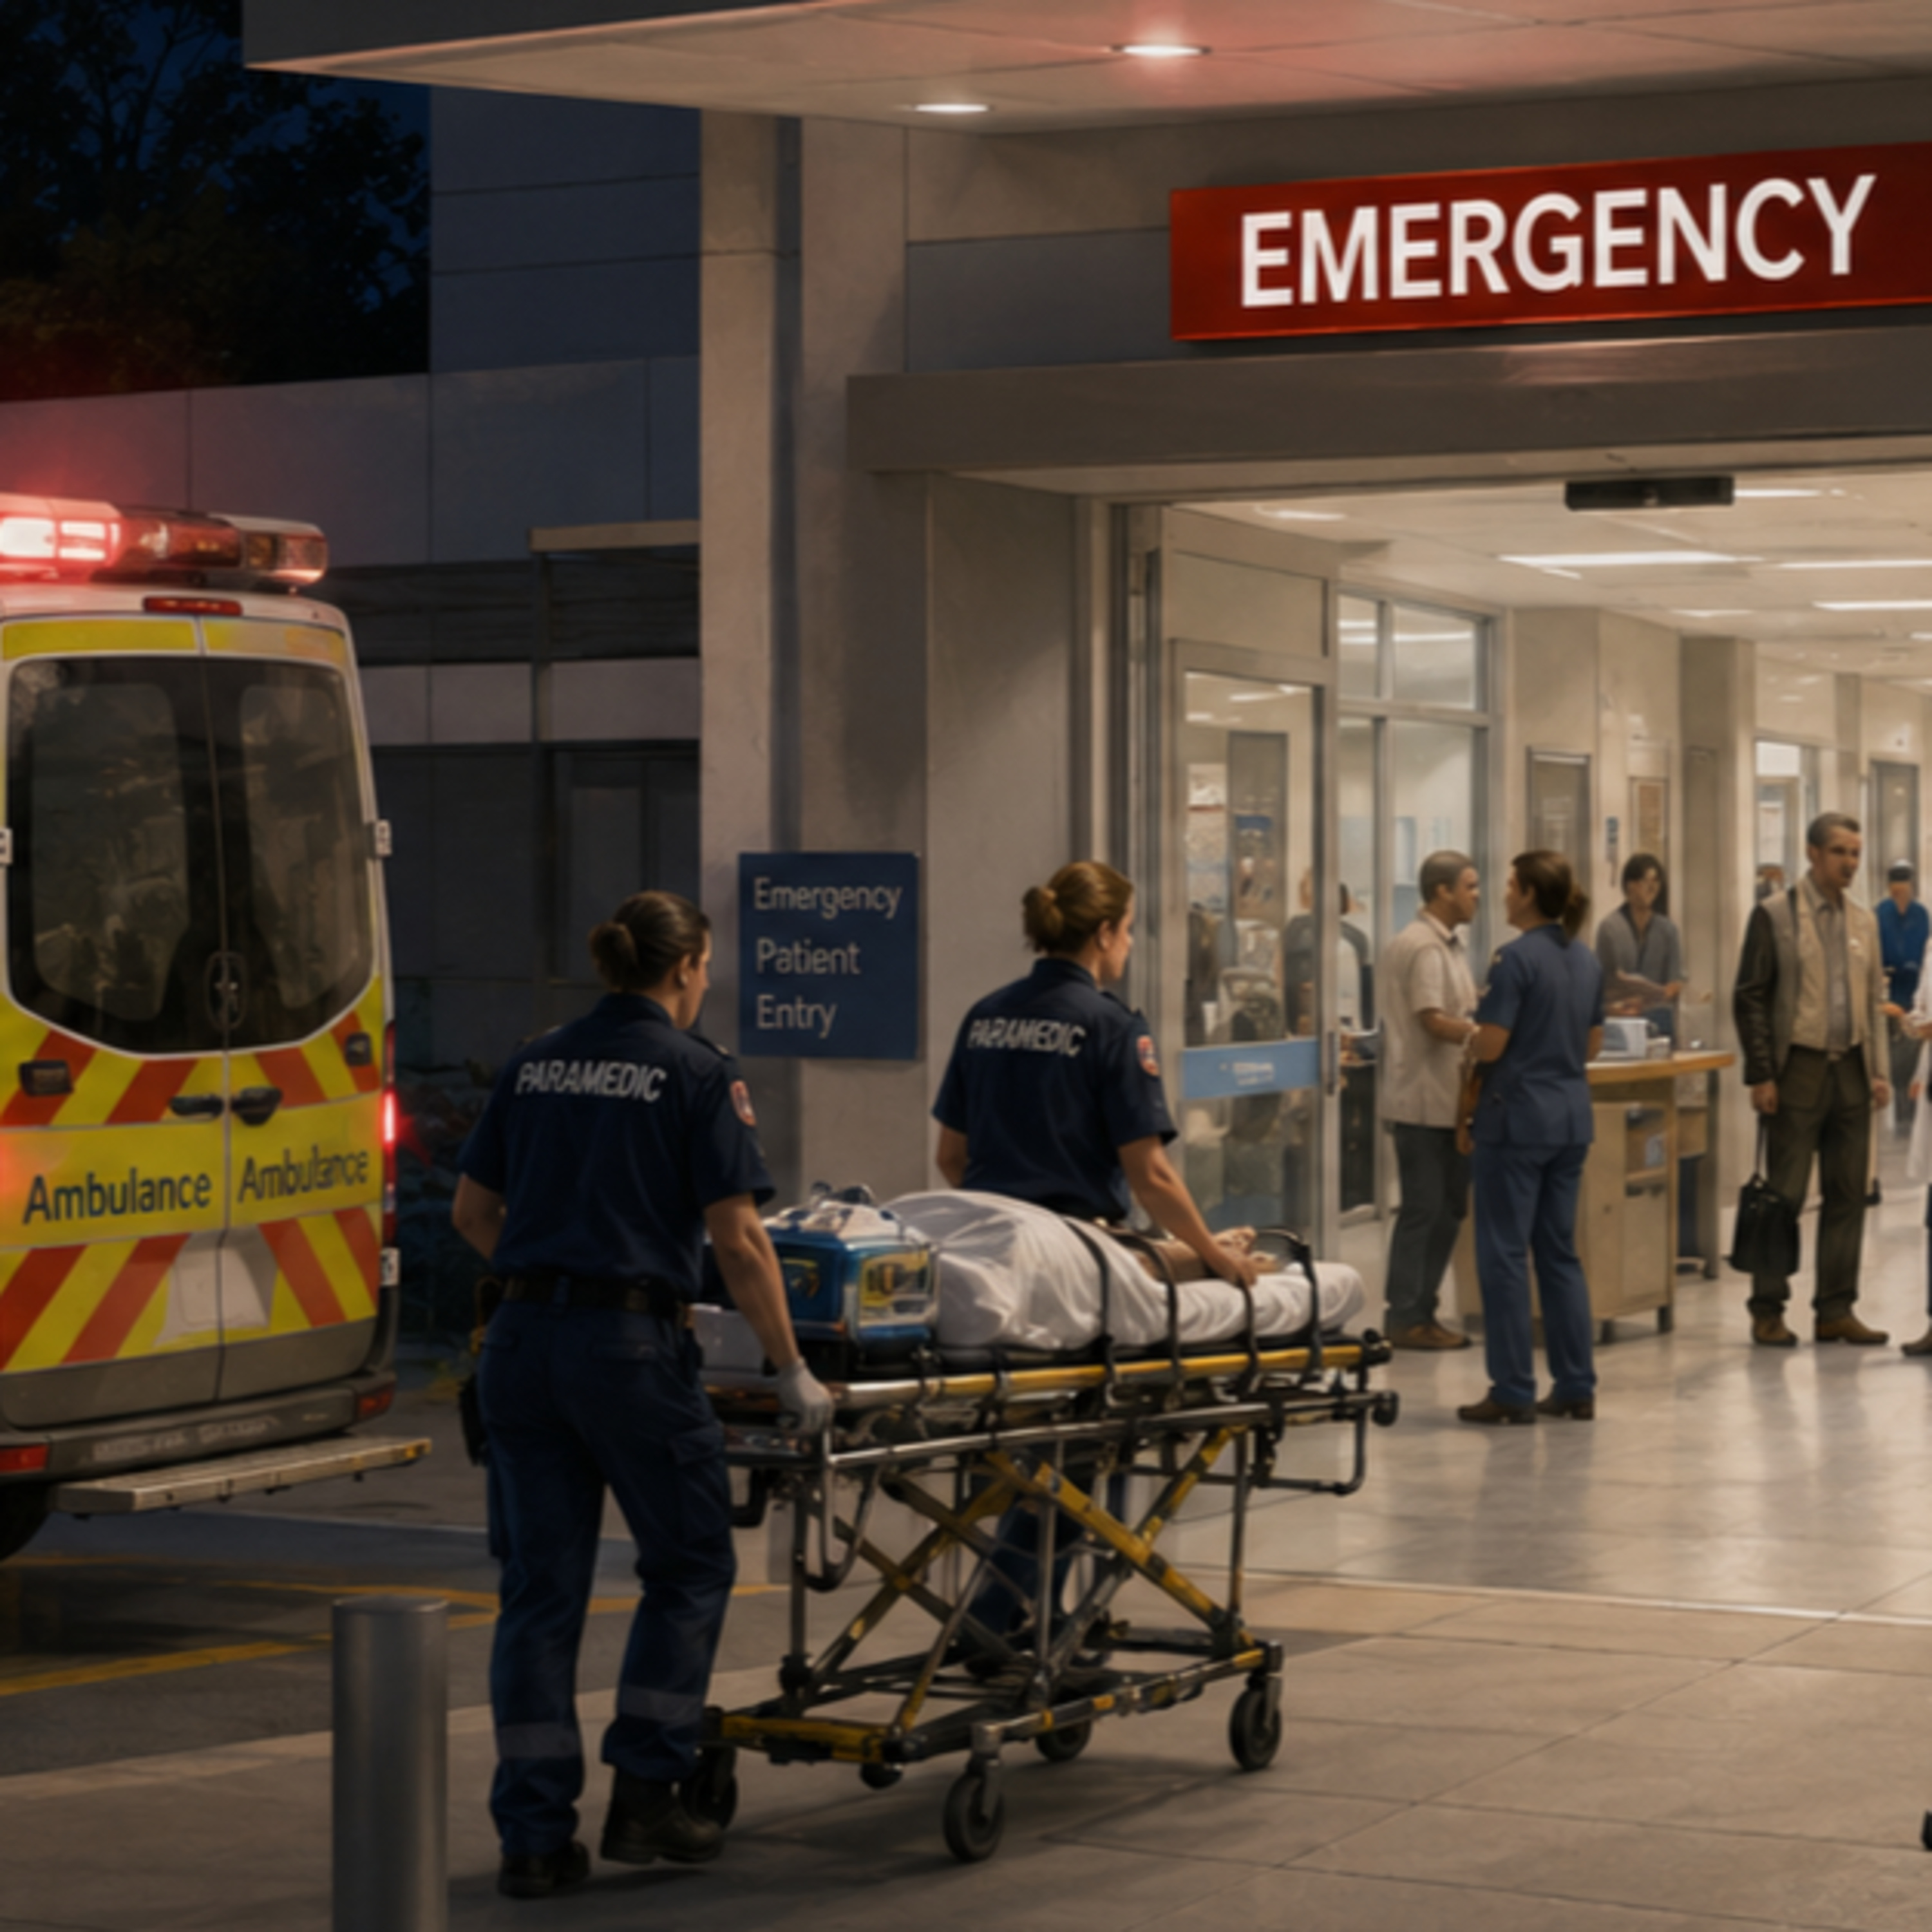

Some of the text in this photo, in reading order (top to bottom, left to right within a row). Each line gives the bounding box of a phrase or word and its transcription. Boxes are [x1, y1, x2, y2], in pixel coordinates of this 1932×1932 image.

[1241, 175, 1875, 307] EMERGENCY
[754, 877, 902, 920] Emergency
[757, 937, 861, 974] Patient
[757, 994, 837, 1038] Entry
[967, 1017, 1086, 1057] PARAMEDIC
[516, 1059, 667, 1103] PARAMEDIC
[238, 1144, 368, 1203] Ambulance
[23, 1167, 212, 1225] Ambulance
